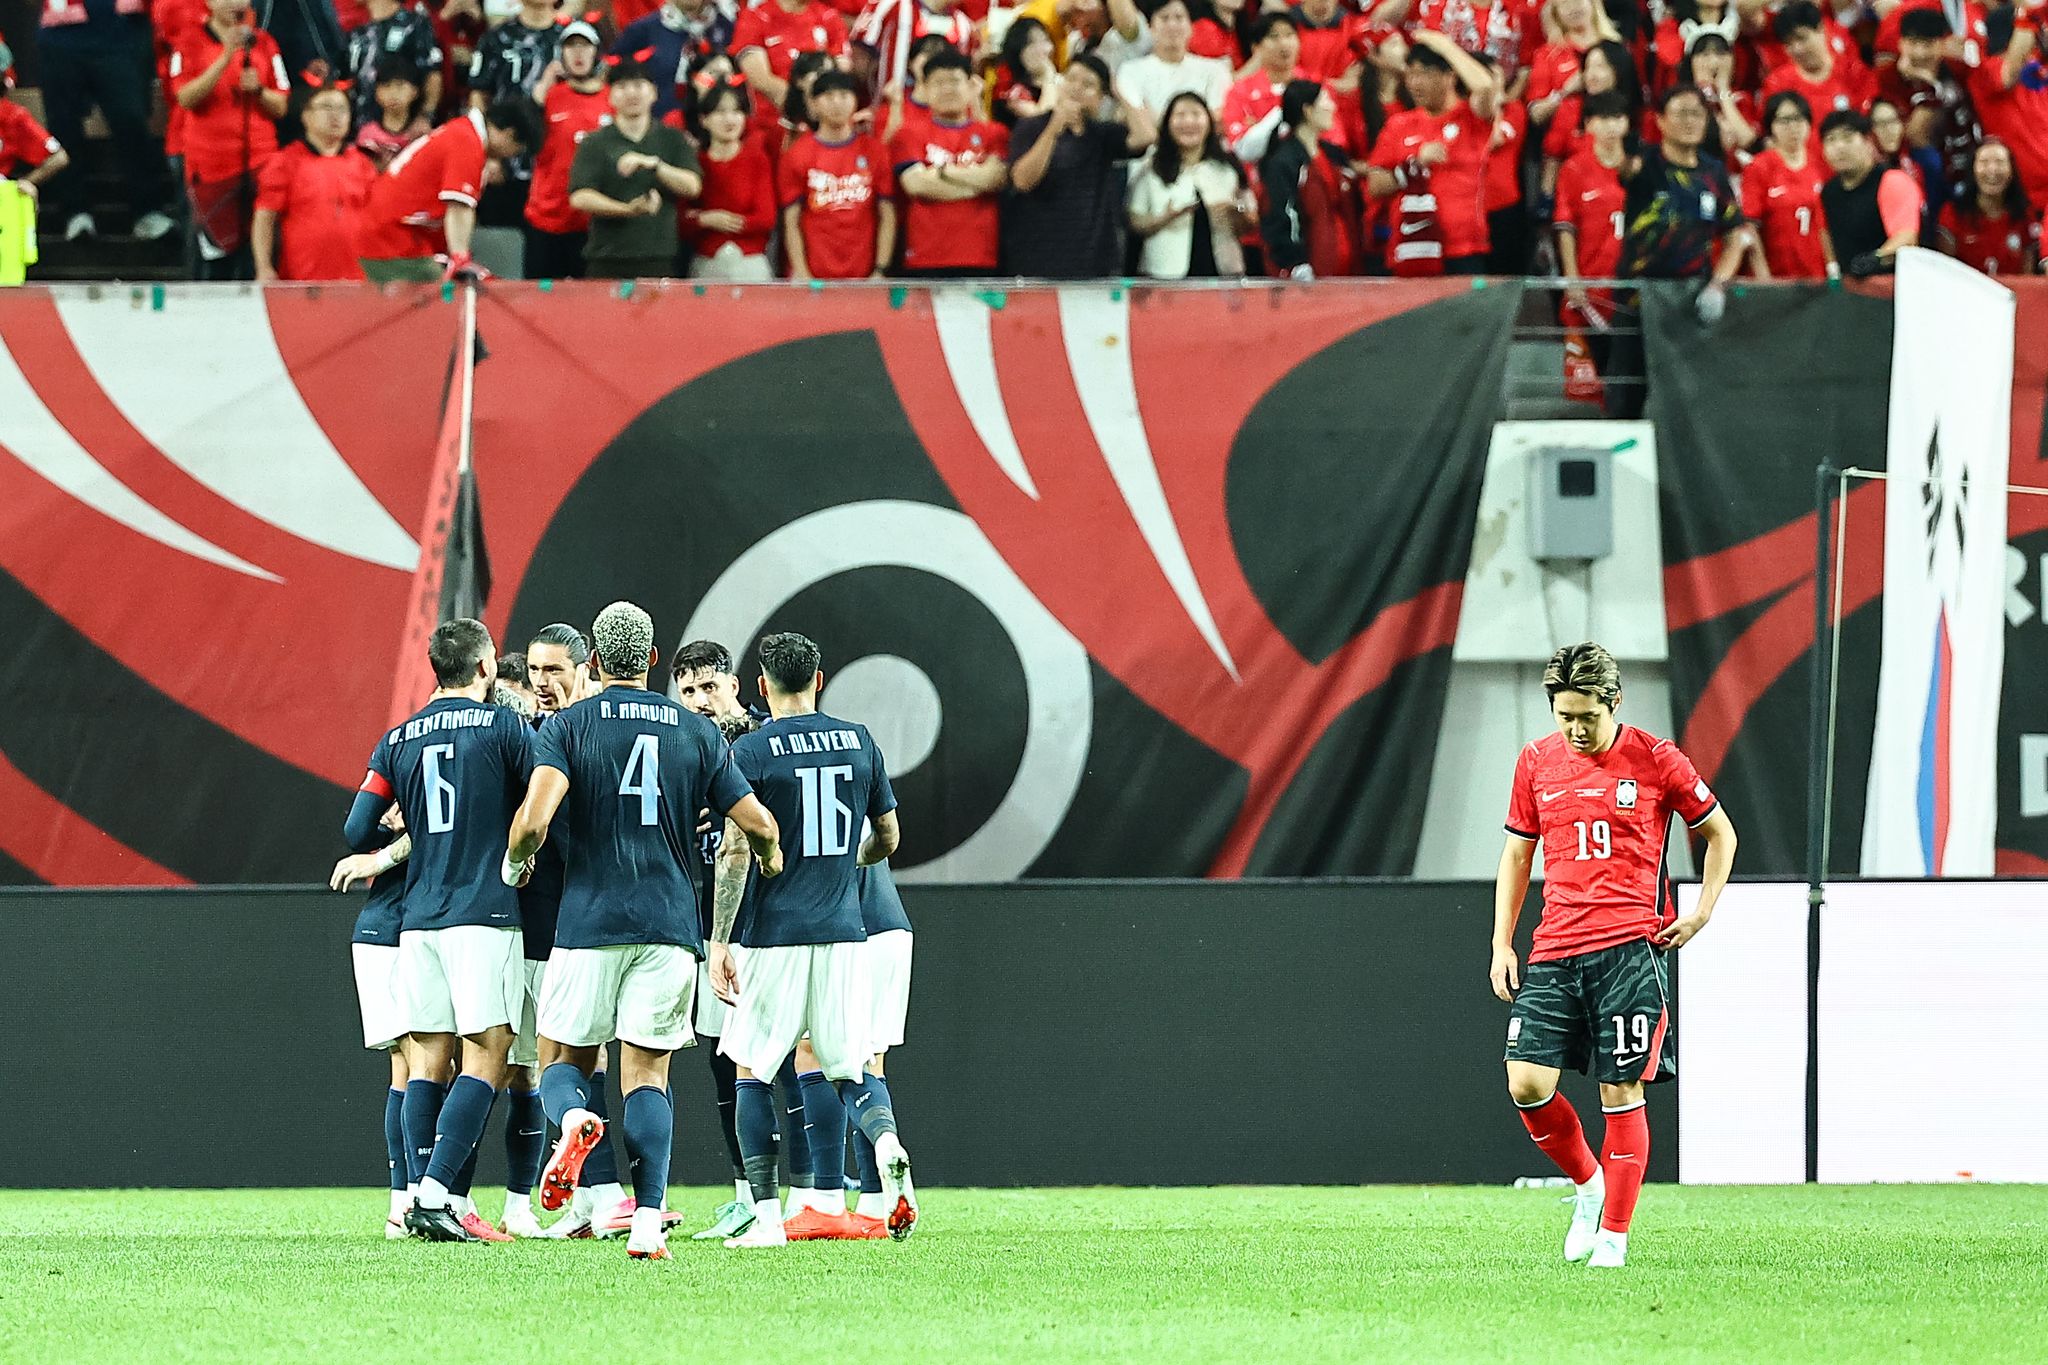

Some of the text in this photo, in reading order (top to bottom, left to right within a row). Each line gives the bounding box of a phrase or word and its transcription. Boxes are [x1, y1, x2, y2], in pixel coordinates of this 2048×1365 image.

[422, 743, 456, 834] 6
[618, 733, 662, 826] 4
[794, 764, 853, 857] 16
[1573, 820, 1612, 861] 19
[1612, 1013, 1649, 1055] 19
